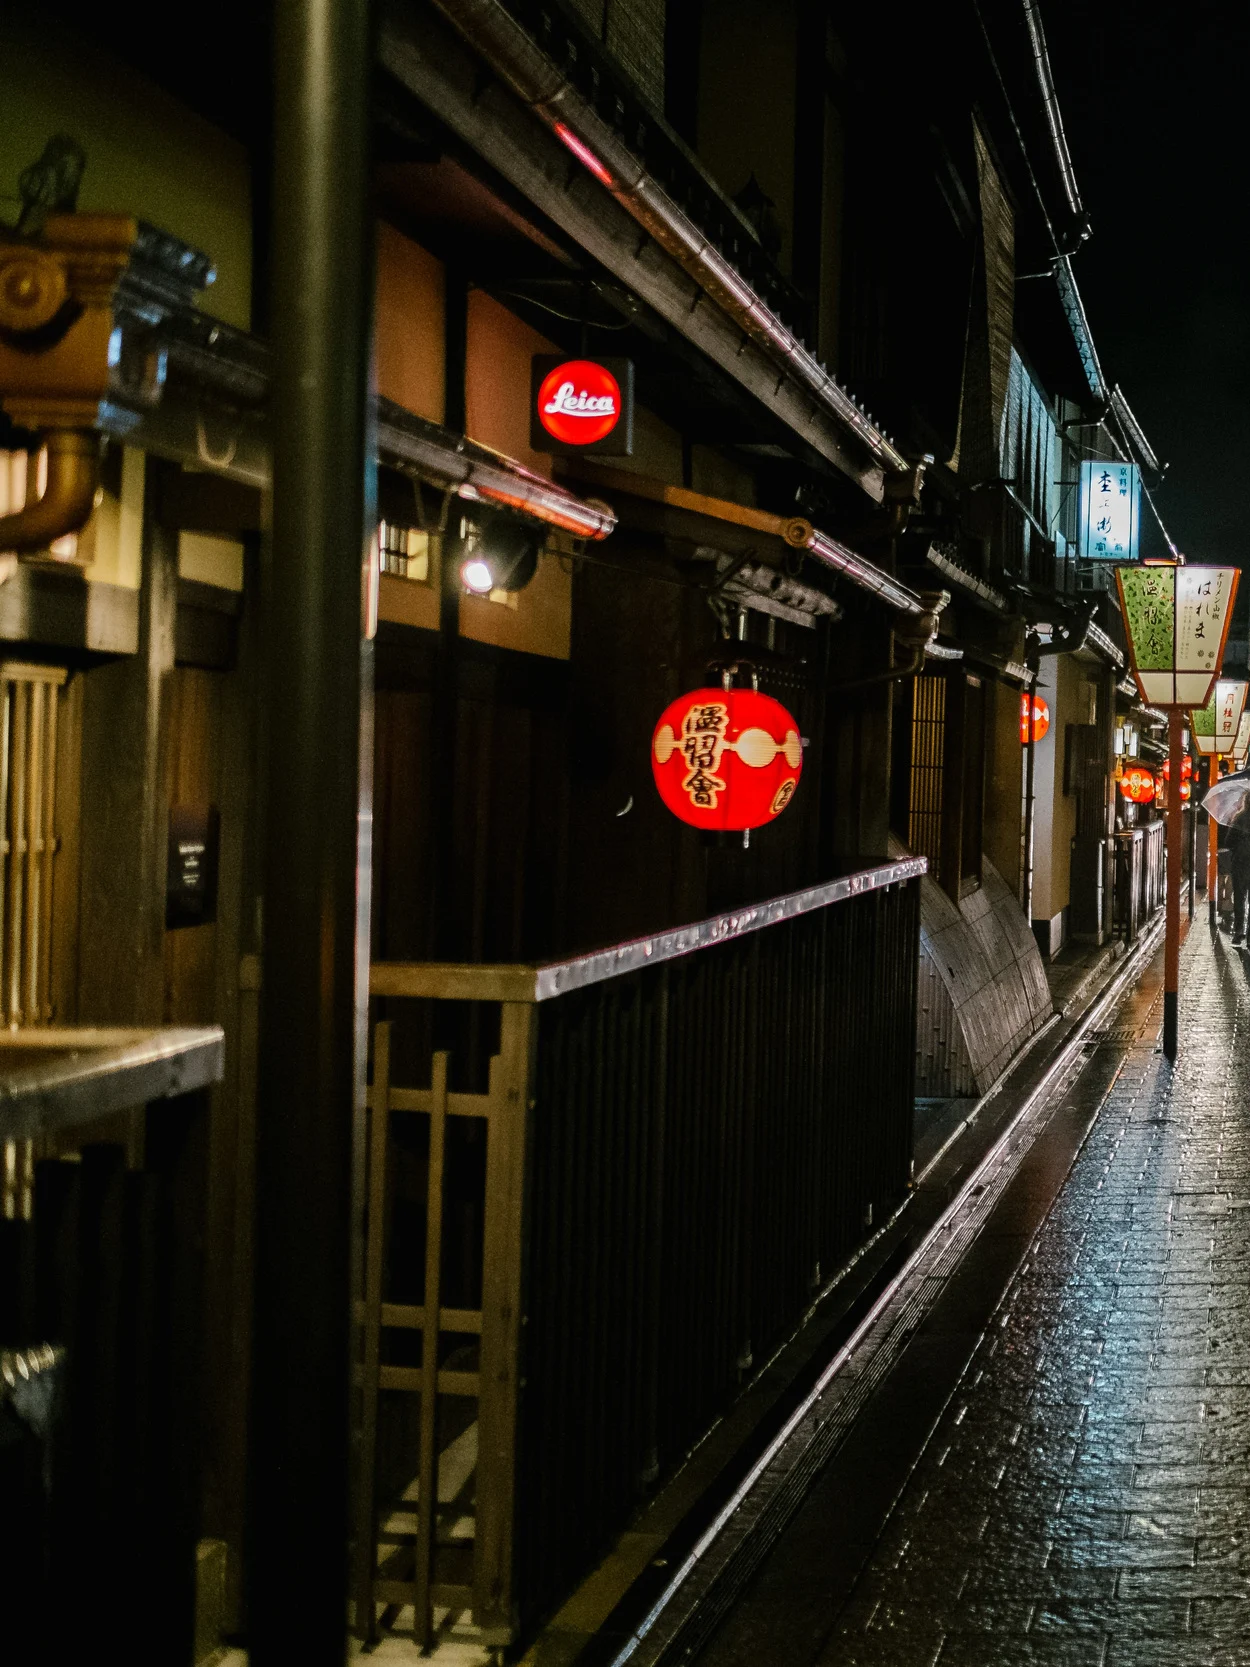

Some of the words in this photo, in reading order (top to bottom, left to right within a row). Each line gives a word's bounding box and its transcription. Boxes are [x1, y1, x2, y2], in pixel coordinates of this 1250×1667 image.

[544, 381, 616, 417] Leica
[1119, 467, 1128, 497] 京料理
[1194, 580, 1212, 639] はれま
[1212, 572, 1225, 621] チリメン山椒
[1222, 693, 1235, 733] 月桂冠
